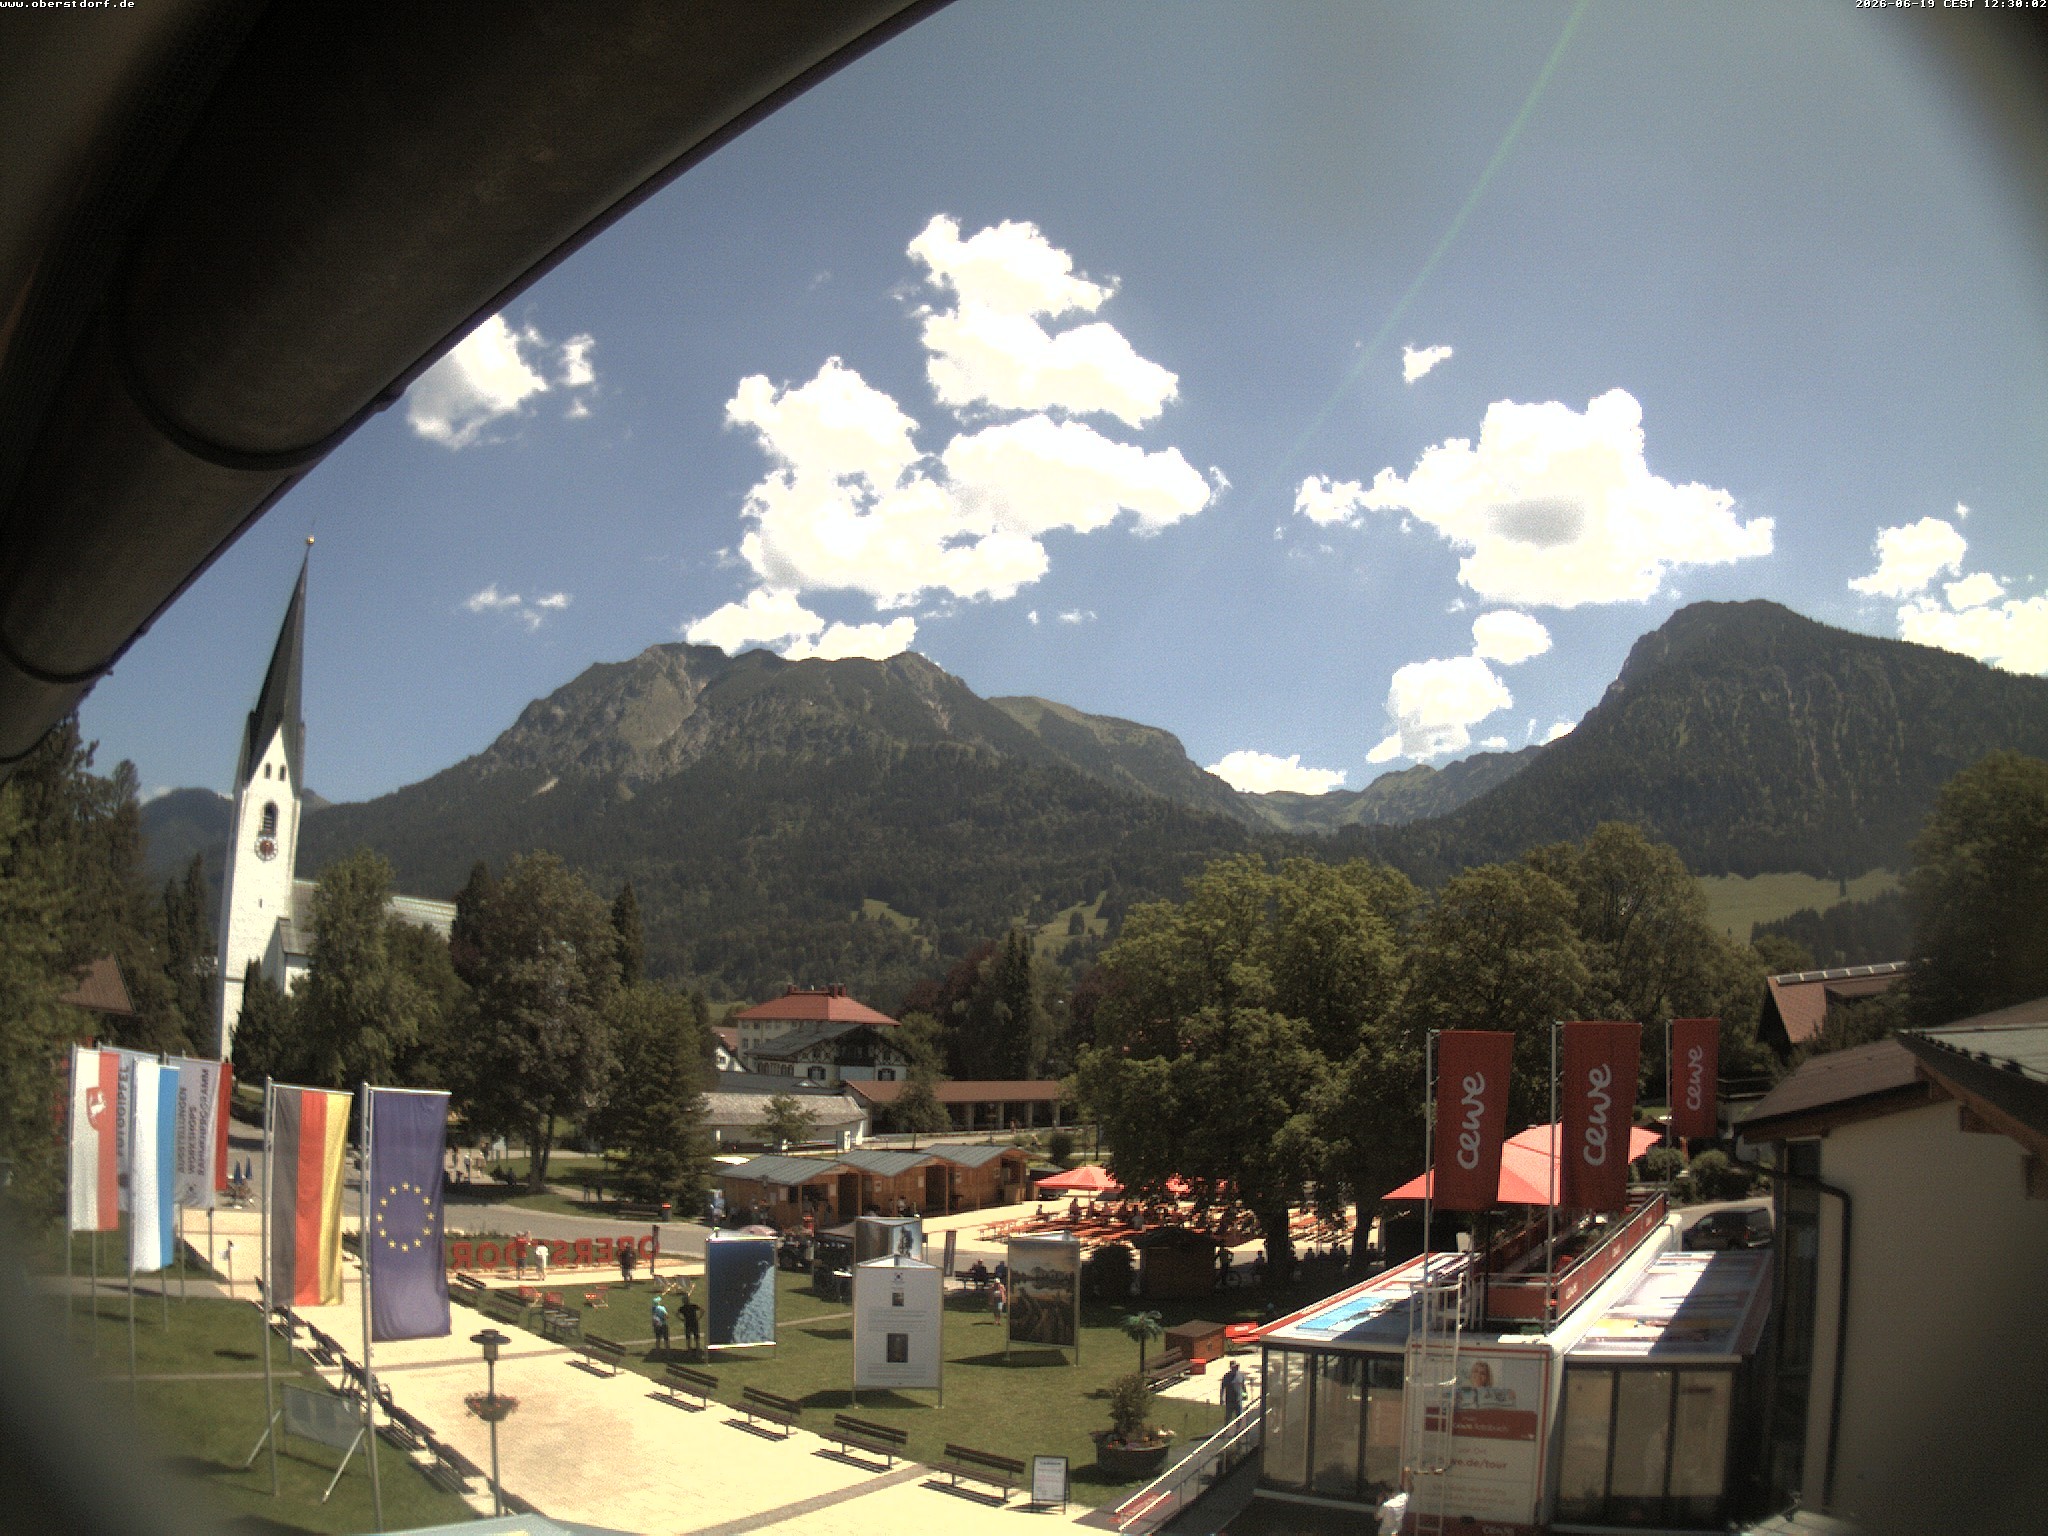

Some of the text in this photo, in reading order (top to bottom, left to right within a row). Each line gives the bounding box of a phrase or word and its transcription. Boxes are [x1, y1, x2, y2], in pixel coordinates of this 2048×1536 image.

[1457, 1071, 1486, 1170] cewe
[1583, 1063, 1612, 1166] cewe
[1686, 1045, 1703, 1111] cewe
